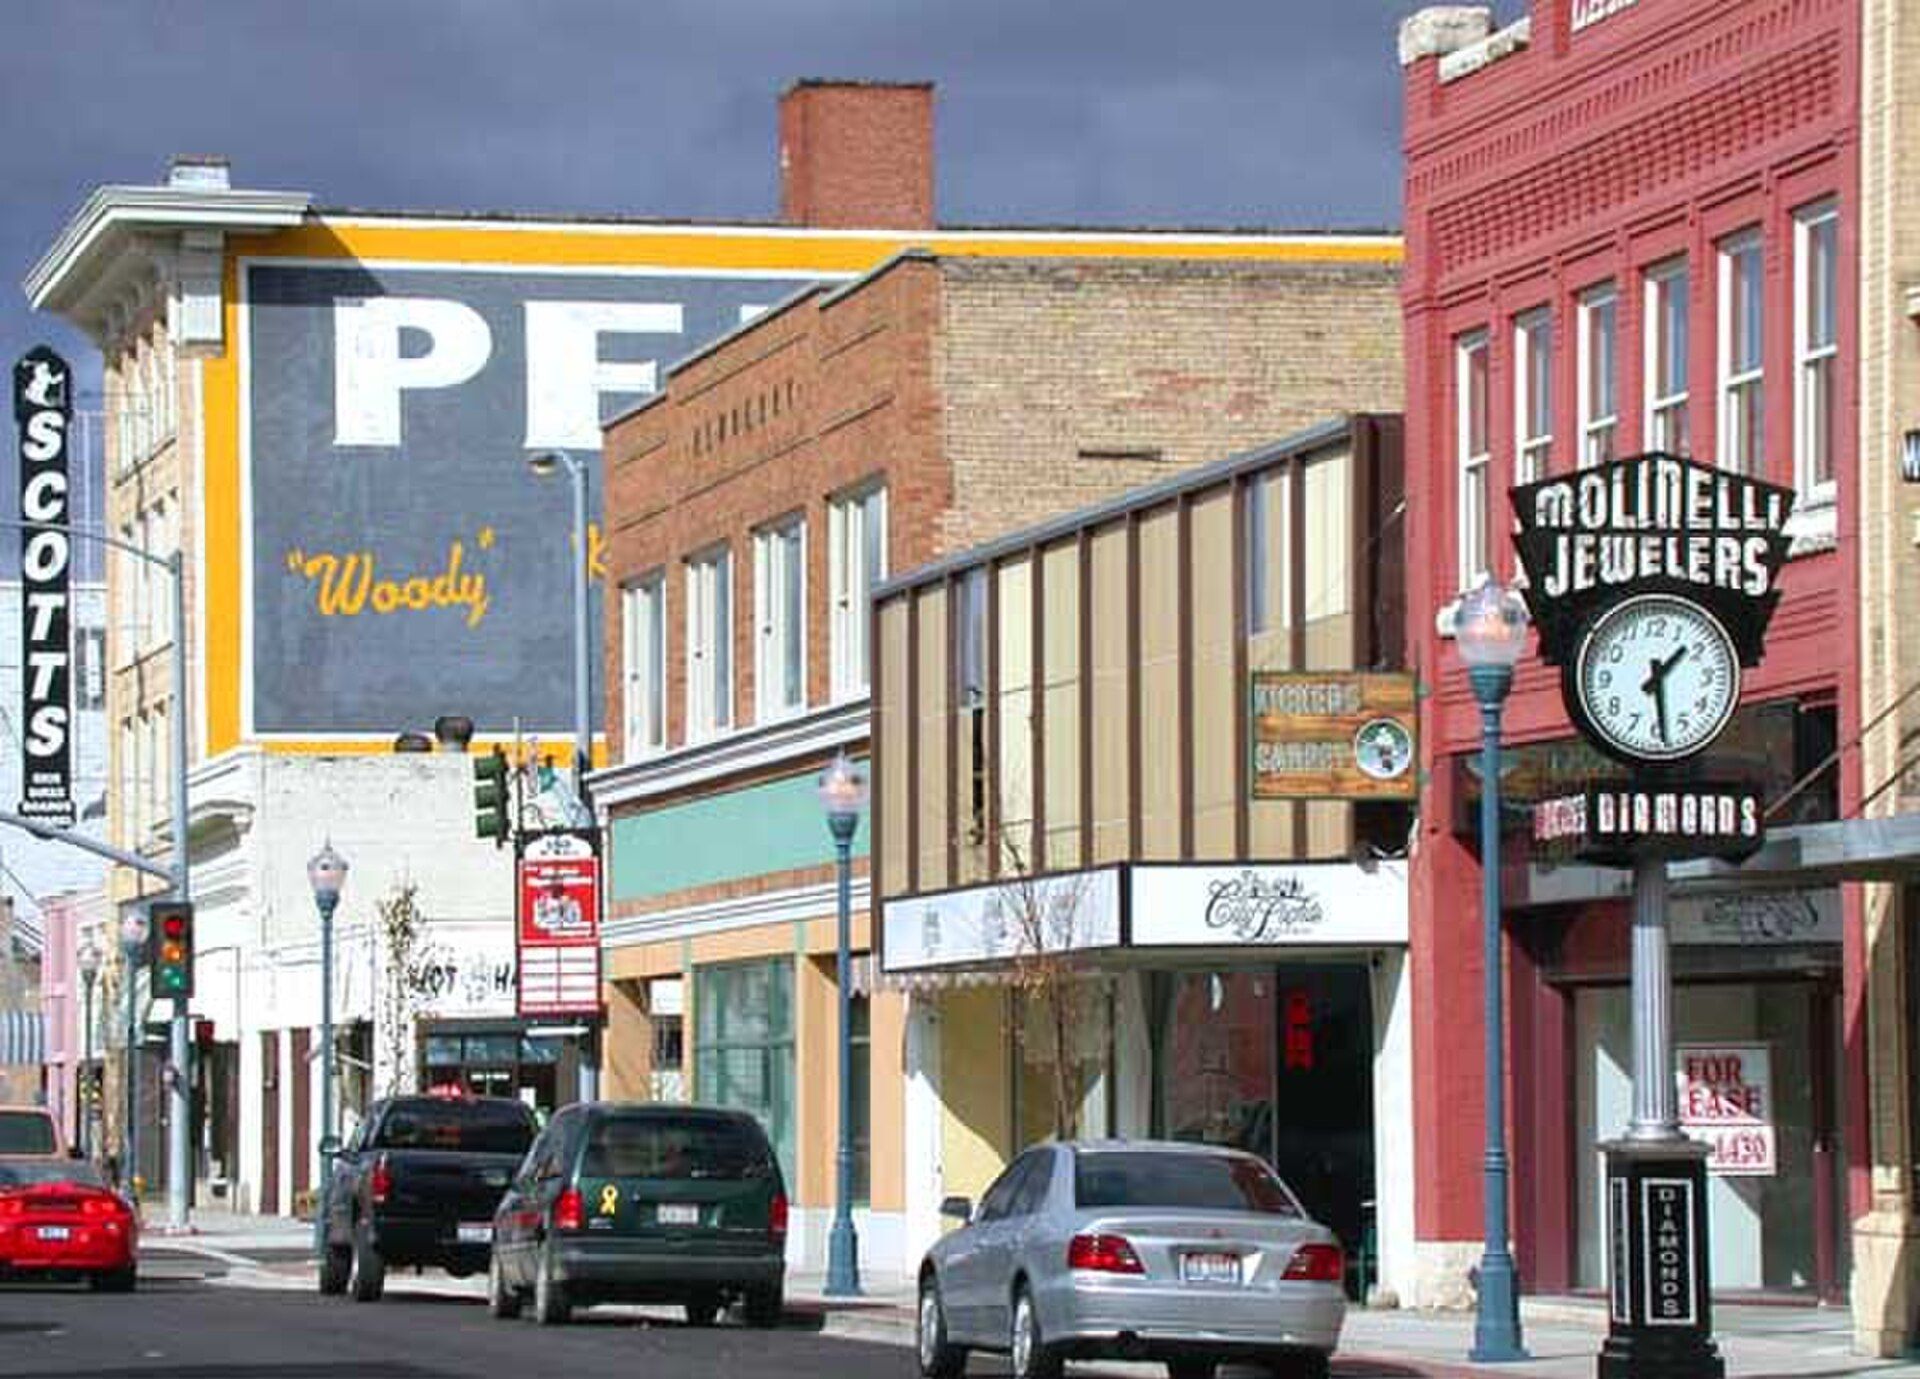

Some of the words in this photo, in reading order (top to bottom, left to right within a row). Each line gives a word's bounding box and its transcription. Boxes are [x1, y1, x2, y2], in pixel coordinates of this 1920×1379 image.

[333, 296, 768, 450] PE
[1534, 459, 1781, 531] MOLINELLI
[1544, 533, 1769, 598] JEWELERS
[23, 410, 69, 757] SCOTTS
[1643, 616, 1667, 638] 12
[1689, 641, 1706, 662] 2
[1597, 669, 1613, 690] 9
[1700, 666, 1715, 688] 3
[1608, 695, 1620, 717] 8
[1627, 712, 1641, 733] 7
[1676, 711, 1691, 733] 5
[1597, 792, 1757, 837] DIAMONDS
[1685, 1056, 1742, 1083] FOR
[1682, 1083, 1762, 1119] EASE
[1658, 1187, 1682, 1317] DIAMONDS
